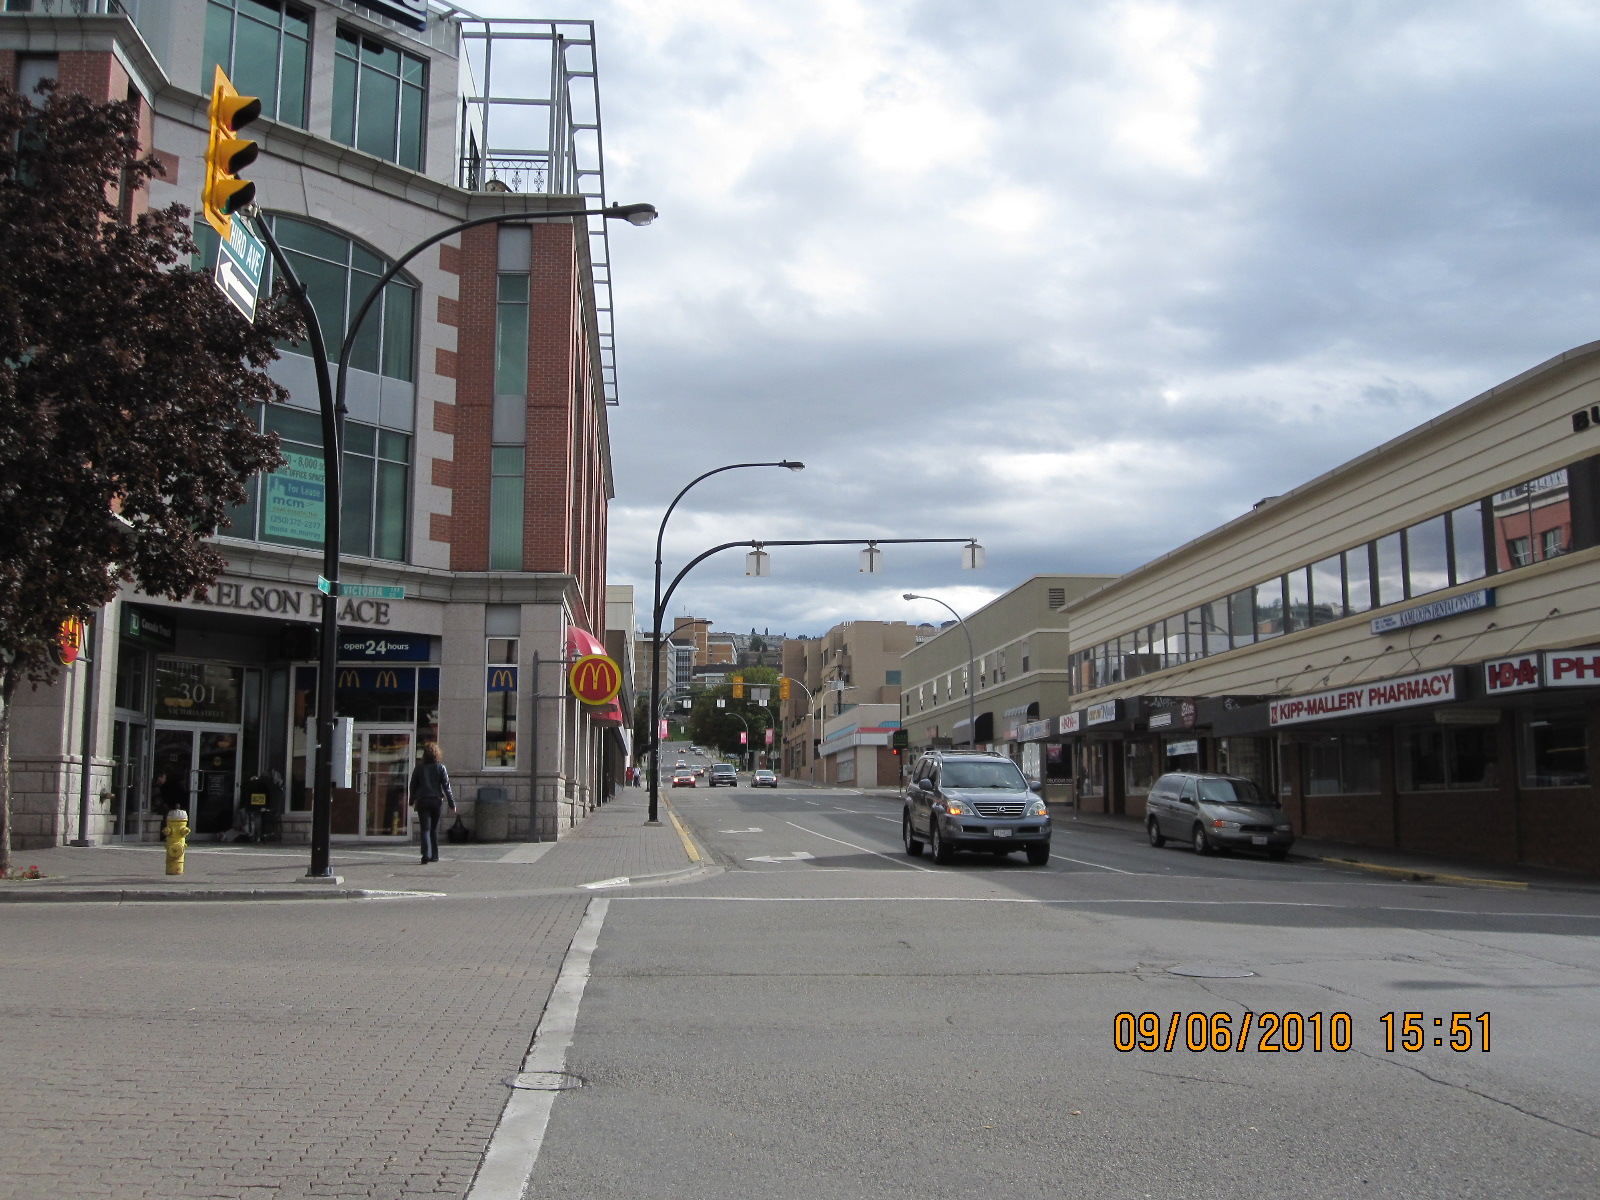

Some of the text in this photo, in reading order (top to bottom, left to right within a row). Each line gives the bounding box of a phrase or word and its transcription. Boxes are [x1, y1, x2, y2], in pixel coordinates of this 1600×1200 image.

[246, 243, 261, 277] AVE
[298, 456, 318, 470] 8,000
[289, 469, 308, 479] OFFICE
[288, 483, 321, 497] For Lease
[273, 496, 305, 508] mcm
[343, 585, 383, 597] VICTORIA
[309, 593, 391, 625] PACE
[1400, 605, 1432, 626] KAMLOOPS
[1432, 599, 1455, 617] DENTAL
[1455, 593, 1481, 612] CENTRE
[343, 640, 409, 654] open 24 hours
[179, 683, 216, 704] 301
[1279, 689, 1364, 720] KIPP-MALLERY
[1368, 673, 1452, 707] PHARMACY
[168, 707, 200, 716] VICTORIA
